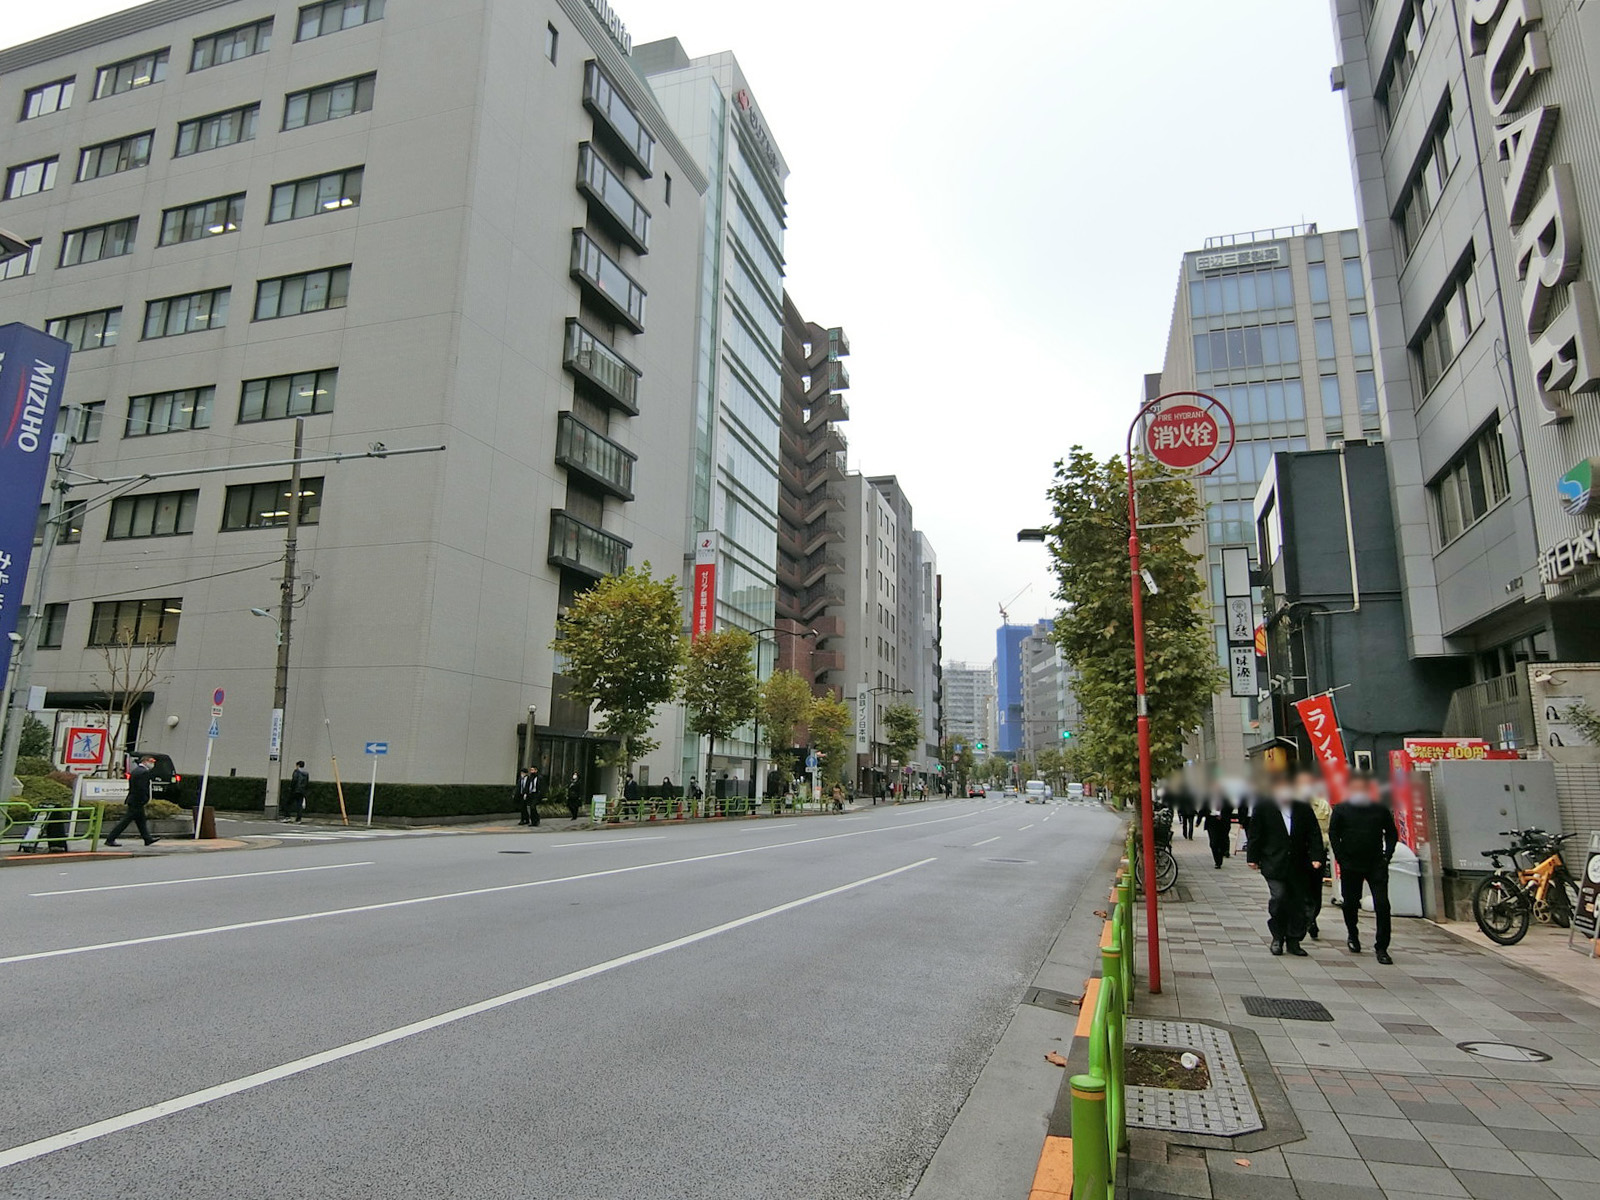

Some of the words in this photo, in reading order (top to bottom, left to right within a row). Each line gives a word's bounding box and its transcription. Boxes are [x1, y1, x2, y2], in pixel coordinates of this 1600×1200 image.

[1198, 247, 1279, 270] 田辺三菱製薬
[18, 358, 56, 453] MIZUHO
[1157, 413, 1172, 422] FIRE
[1173, 410, 1205, 420] HYDRANT
[1152, 421, 1213, 450] 消火栓
